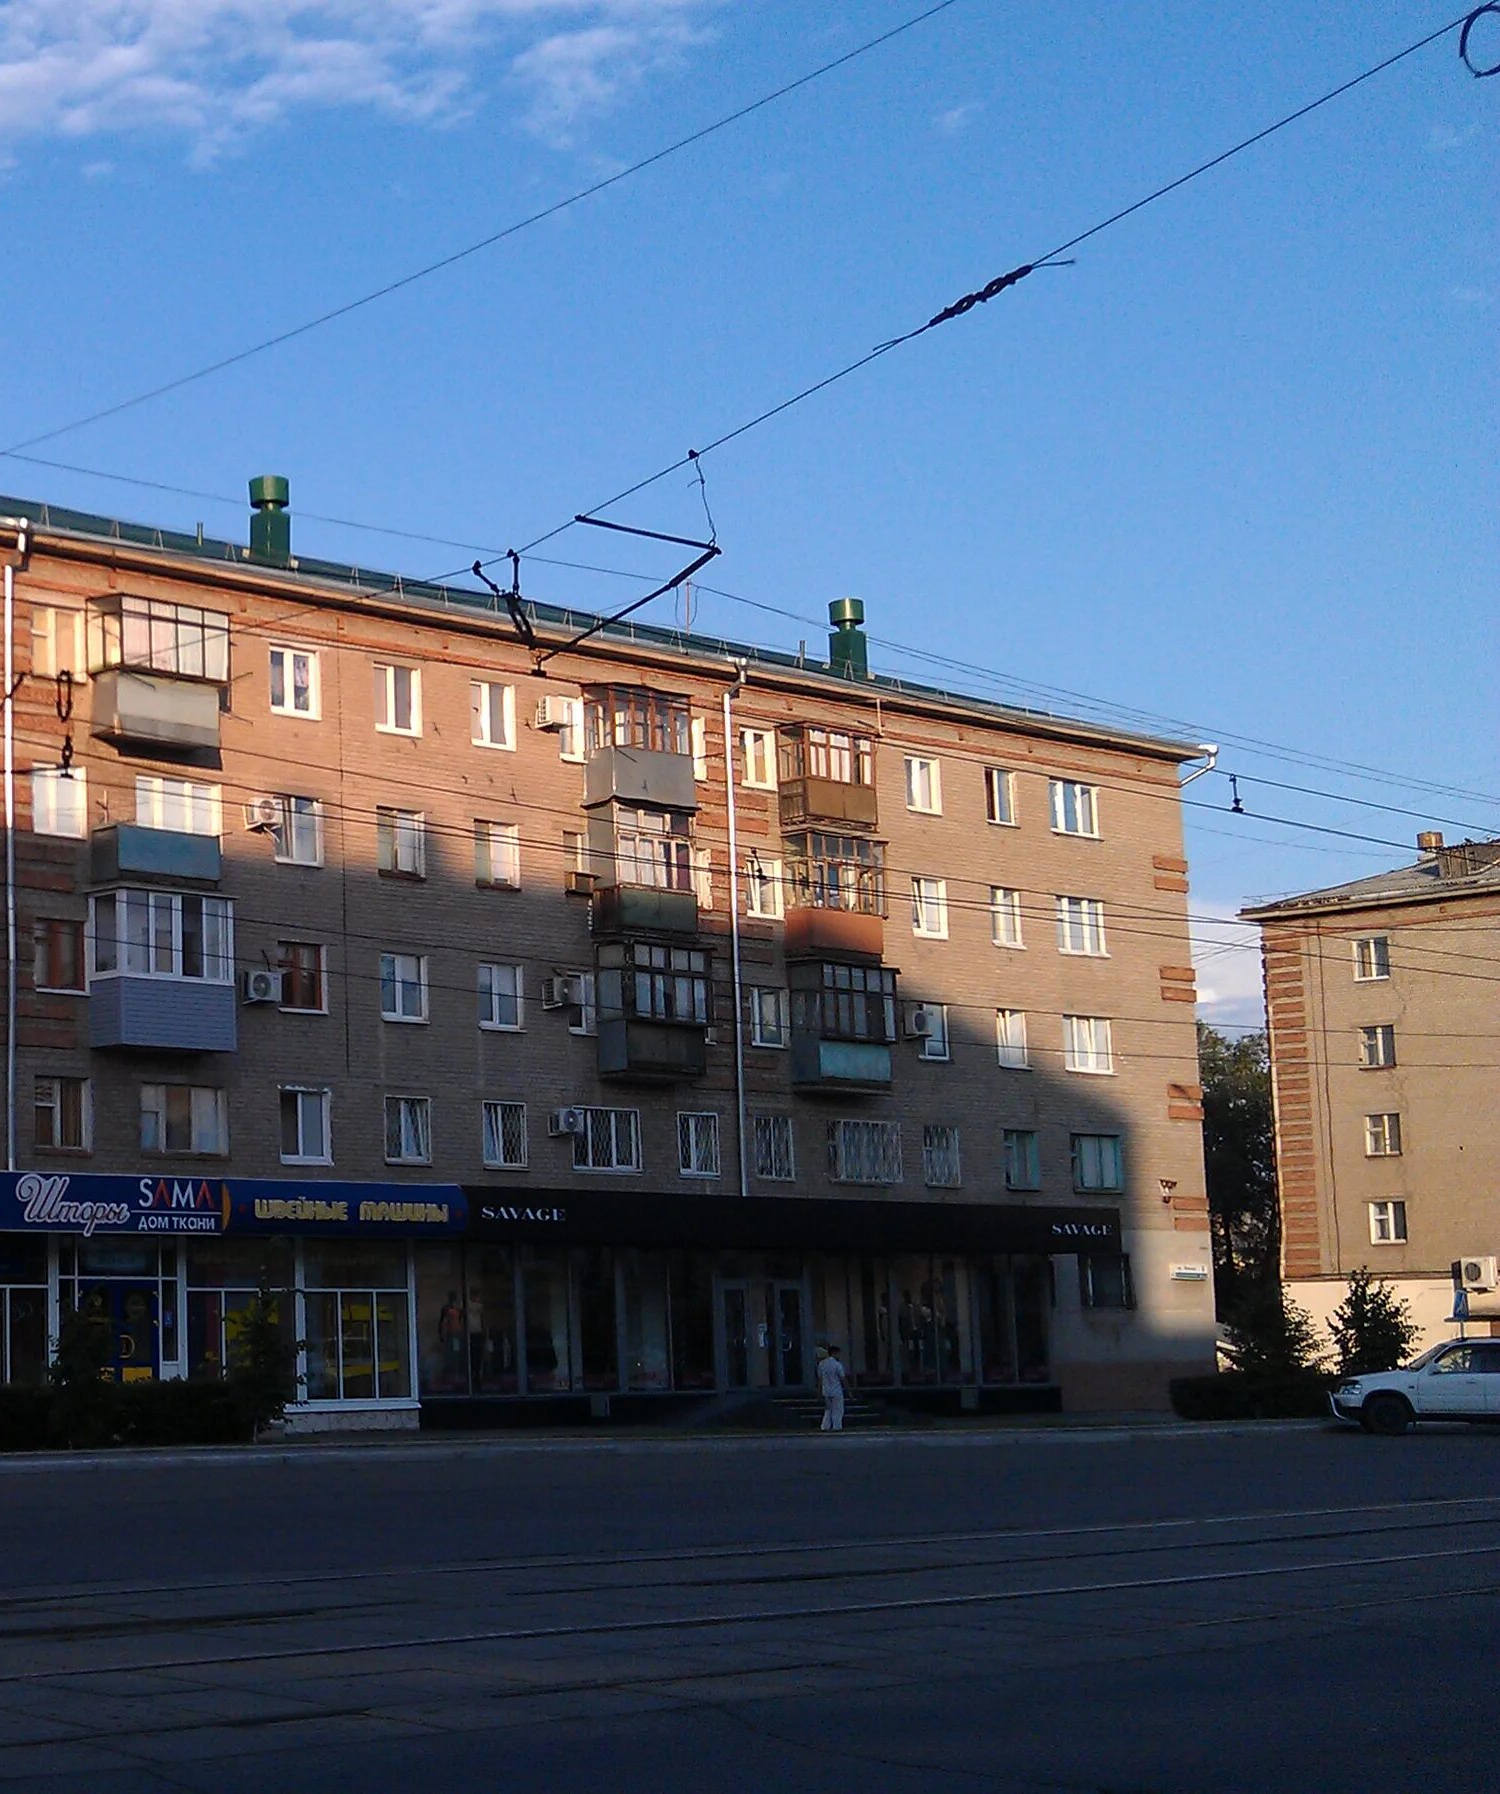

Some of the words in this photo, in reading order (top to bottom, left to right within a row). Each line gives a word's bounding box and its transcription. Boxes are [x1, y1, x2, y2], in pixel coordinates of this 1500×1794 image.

[15, 1173, 131, 1237] Шторы
[254, 1196, 348, 1221] ШВЕЙНЫЕ
[359, 1200, 449, 1223] МАШИНЫ
[481, 1206, 566, 1222] SAVAGE
[1051, 1223, 1113, 1236] SAVAGE
